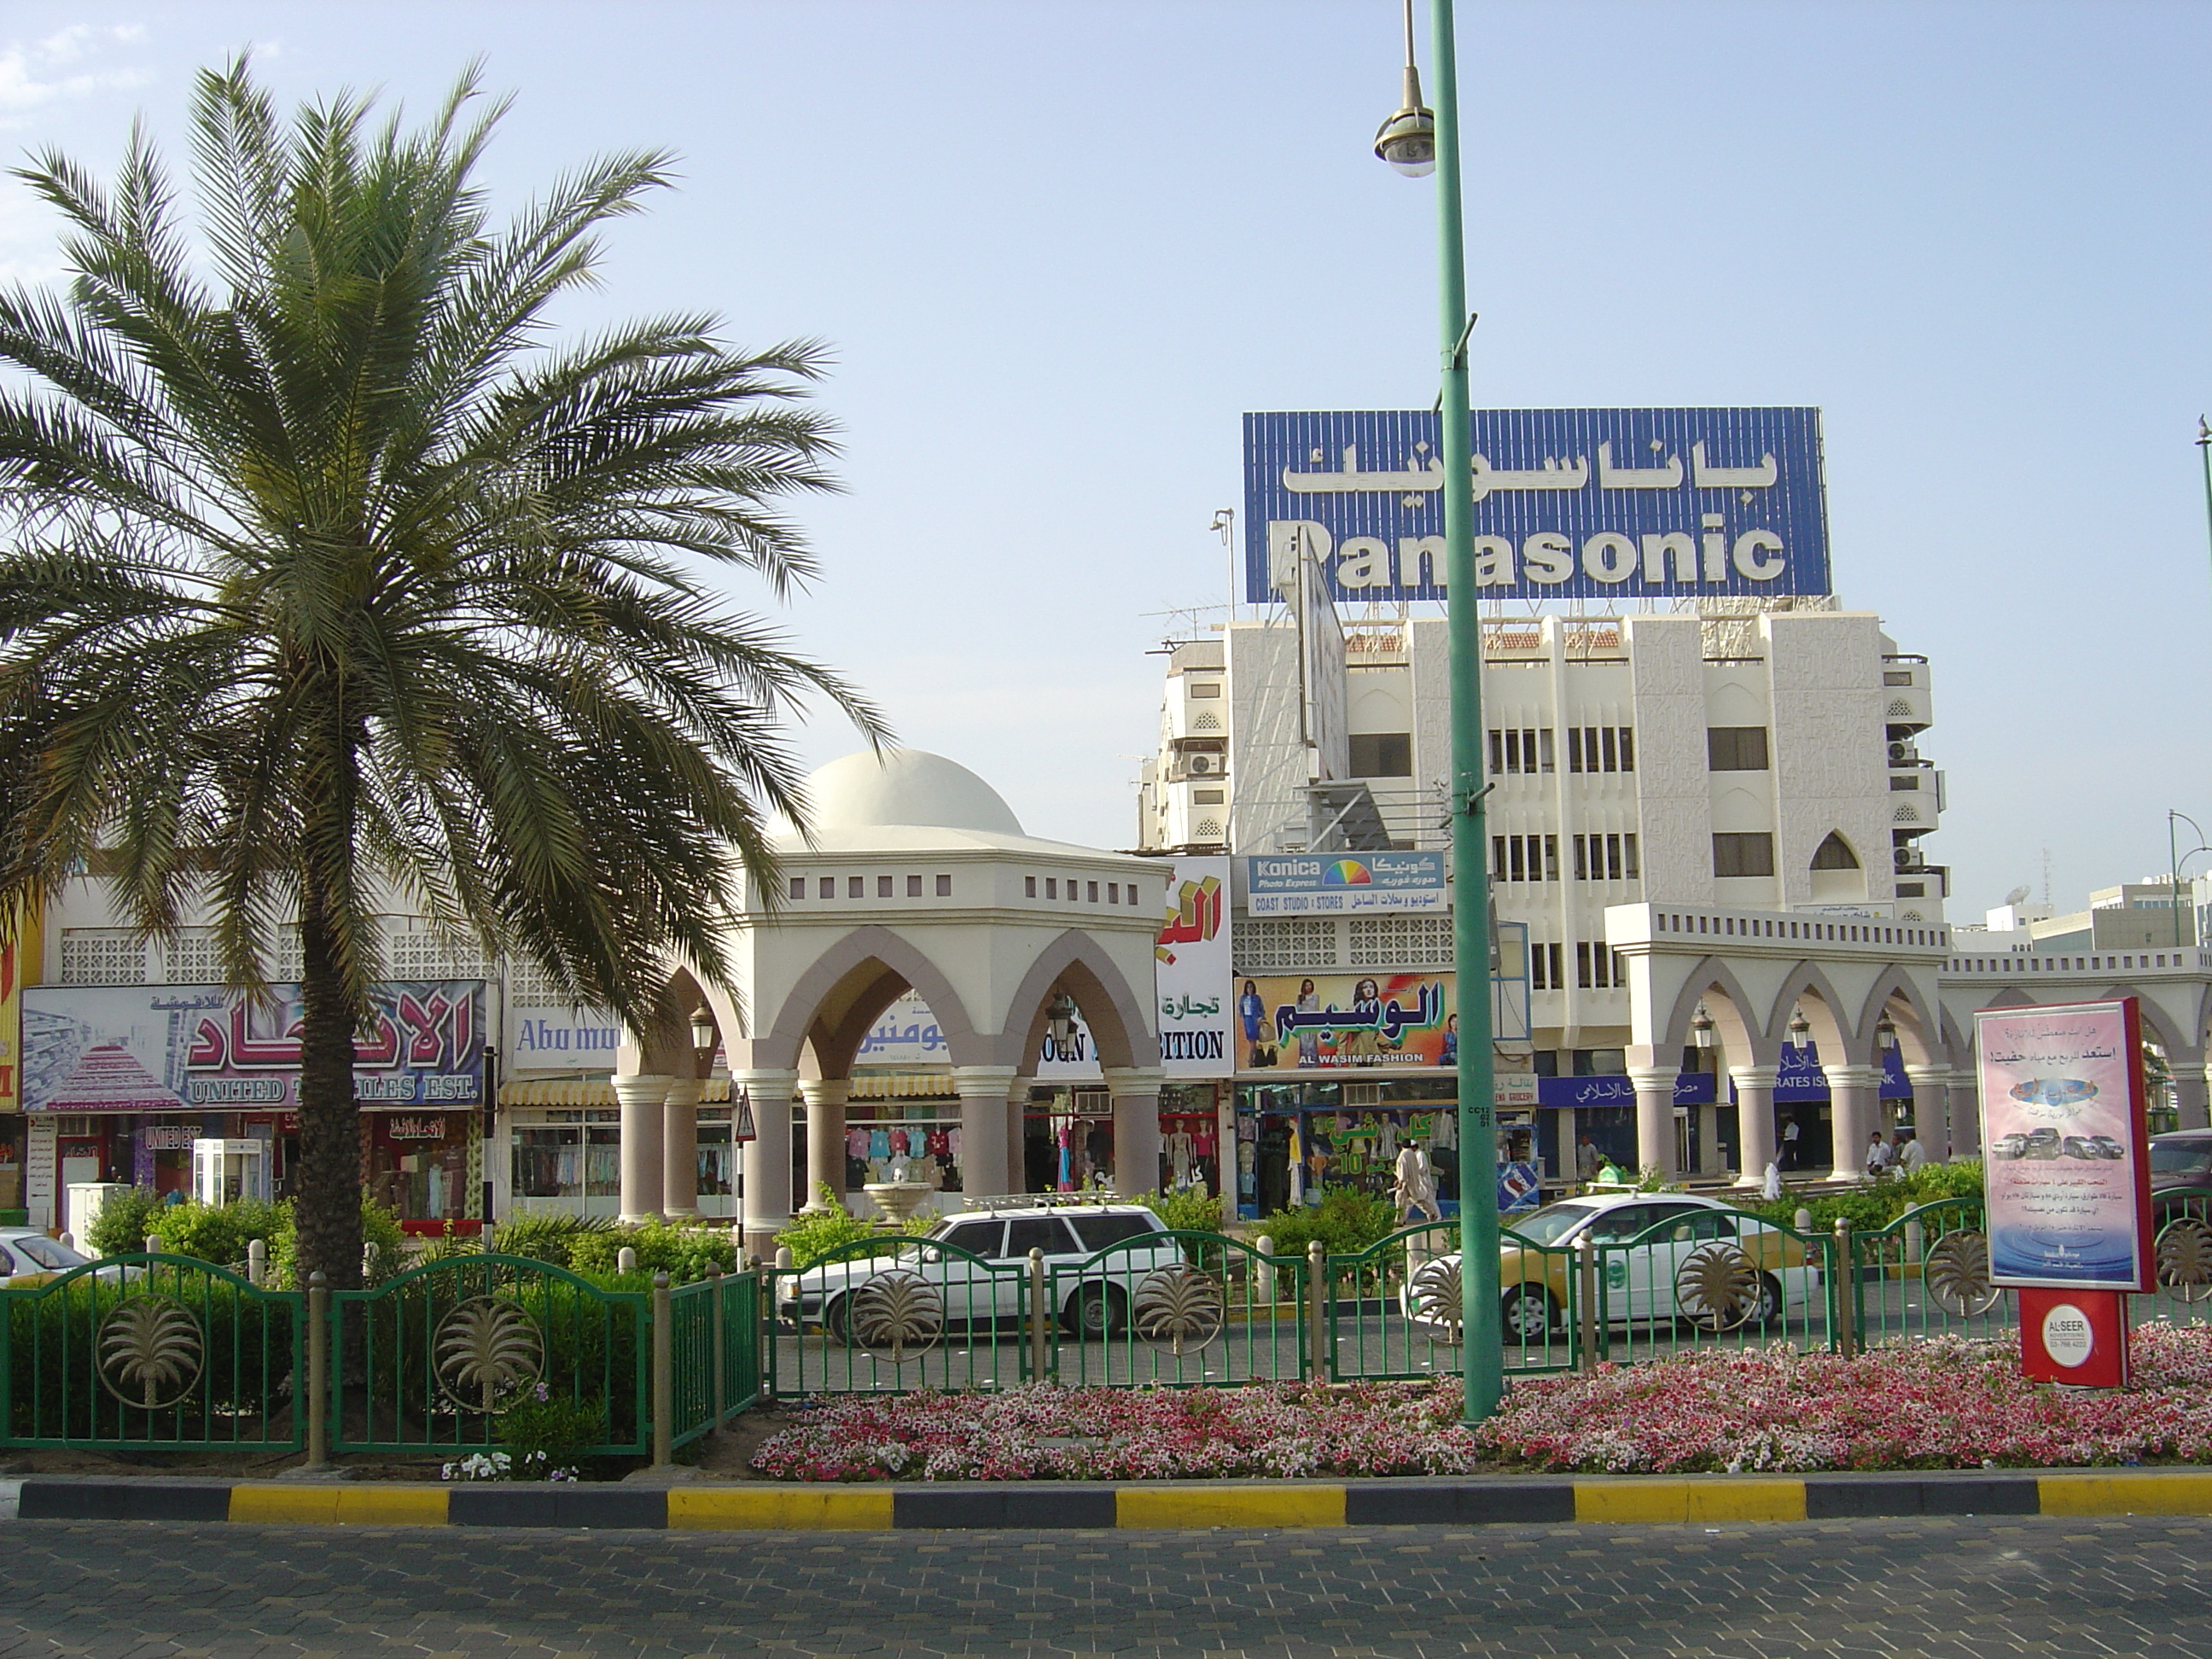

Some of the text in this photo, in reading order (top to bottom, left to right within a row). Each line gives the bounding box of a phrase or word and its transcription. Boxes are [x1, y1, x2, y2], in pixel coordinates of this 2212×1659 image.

[1269, 514, 1786, 589] Panasonic
[1257, 859, 1320, 876] Konica
[1372, 857, 1435, 874] كونيكا
[1258, 878, 1317, 888] Photo Express
[1255, 897, 1278, 911] COAST
[1284, 896, 1308, 911] STUDIO
[1317, 895, 1343, 910] STORES
[1161, 992, 1220, 1021] تجارة
[1273, 980, 1444, 1049] الوسيم
[515, 1019, 621, 1051] Abu mu
[1159, 1030, 1225, 1061] ITION
[1298, 1053, 1424, 1064] AL WASIM FASHION
[189, 1077, 285, 1104] UNITED
[423, 1074, 478, 1100] EST.
[1775, 1076, 1810, 1088] RATES
[1880, 1074, 1895, 1085] NK
[146, 1126, 182, 1150] UNITED
[1339, 1153, 1362, 1174] 10
[1511, 1168, 1532, 1191] PEPS
